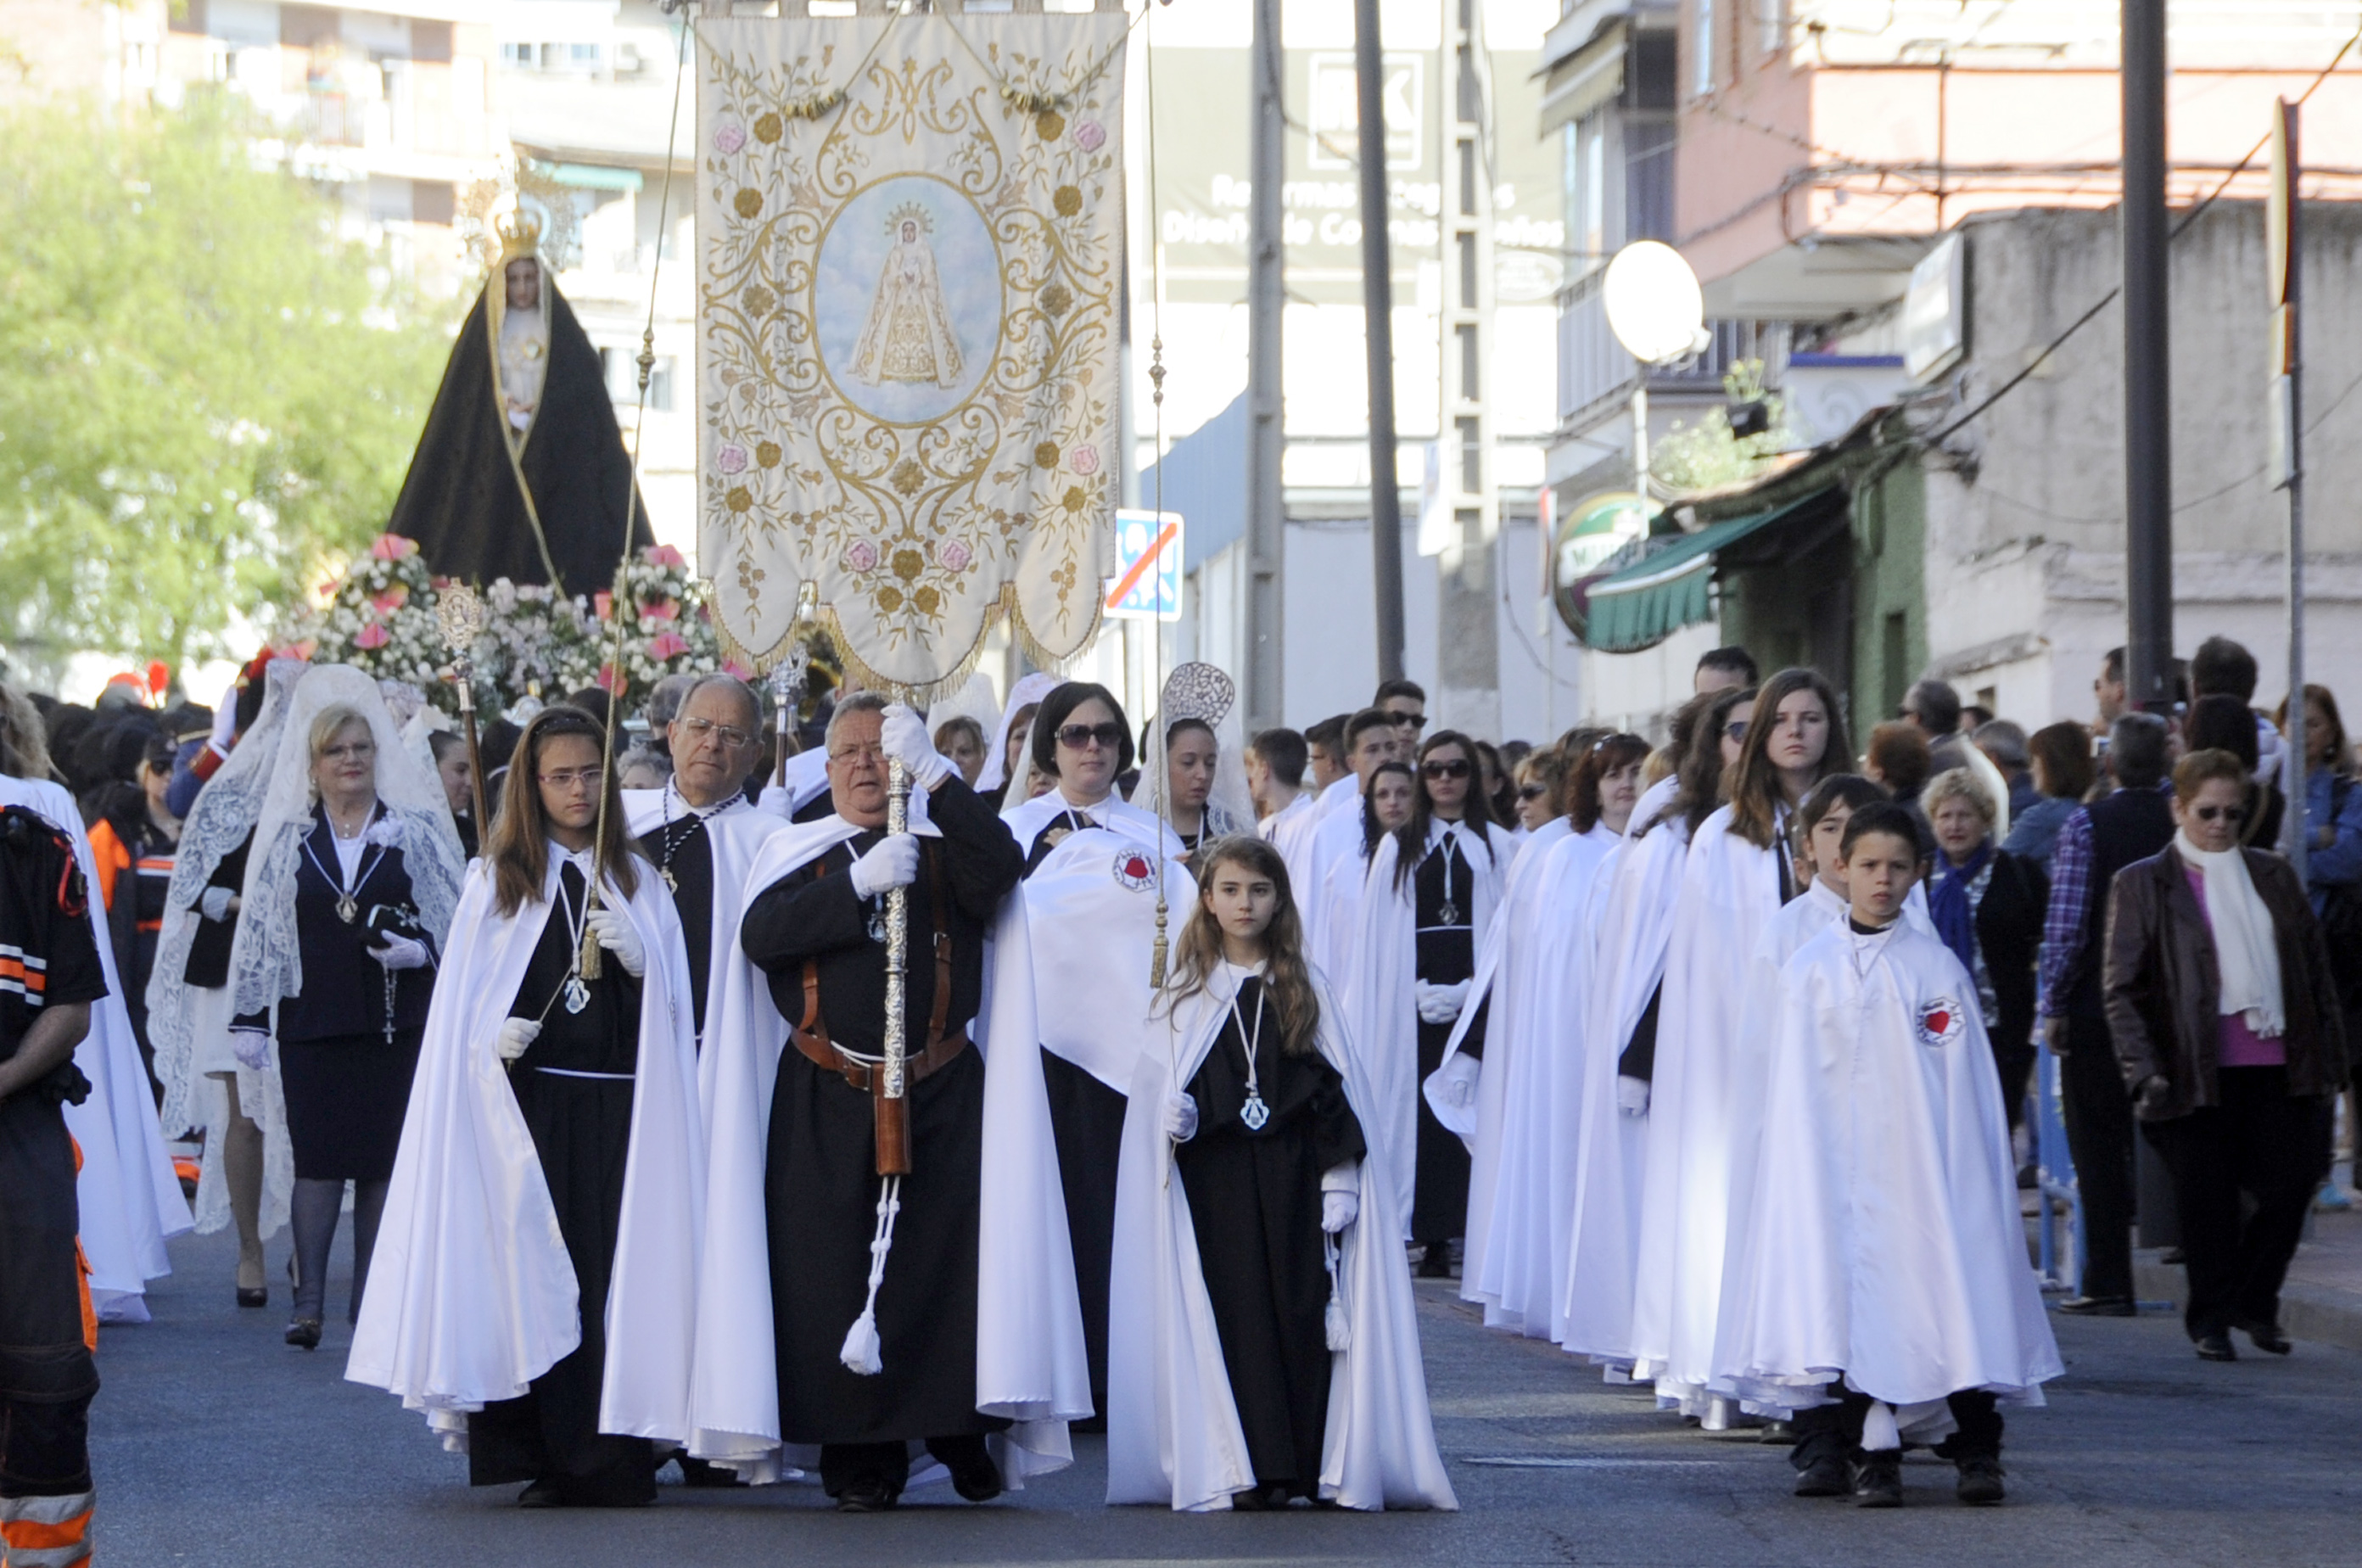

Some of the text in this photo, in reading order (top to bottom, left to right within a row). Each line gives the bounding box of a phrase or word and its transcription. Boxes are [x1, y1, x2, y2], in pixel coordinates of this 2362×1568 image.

[1212, 174, 1357, 208] Rermas
[1162, 210, 1249, 244] Diseñ
[1320, 213, 1439, 245] Conas
[1493, 216, 1564, 246] años
